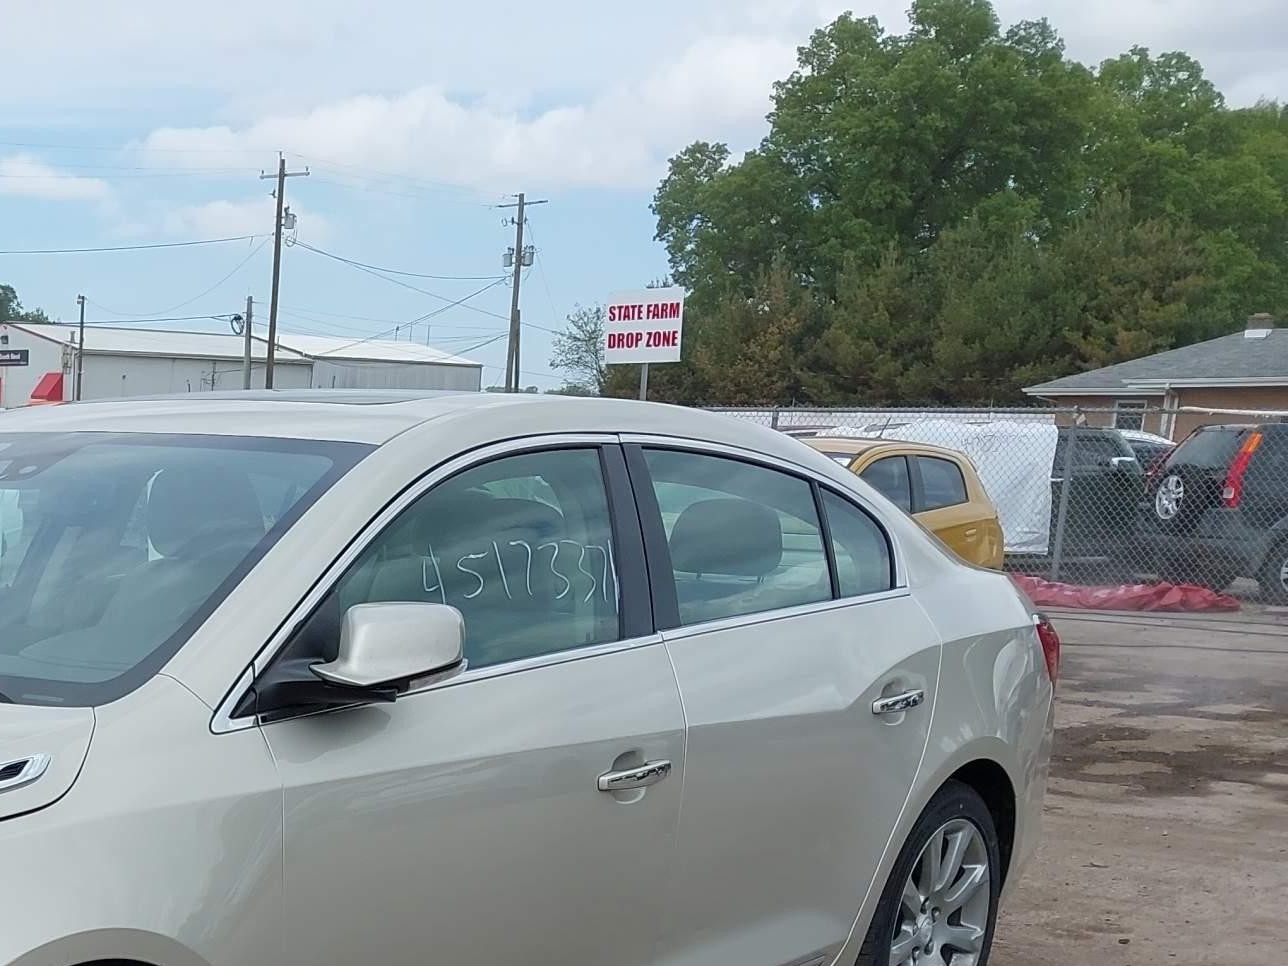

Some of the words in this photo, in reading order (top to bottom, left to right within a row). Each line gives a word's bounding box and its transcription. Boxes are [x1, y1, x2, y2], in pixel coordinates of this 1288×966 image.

[608, 304, 643, 321] STATE
[646, 302, 680, 320] FARM
[607, 332, 643, 349] DROP
[645, 330, 679, 348] ZONE
[422, 539, 620, 615] 45173371
